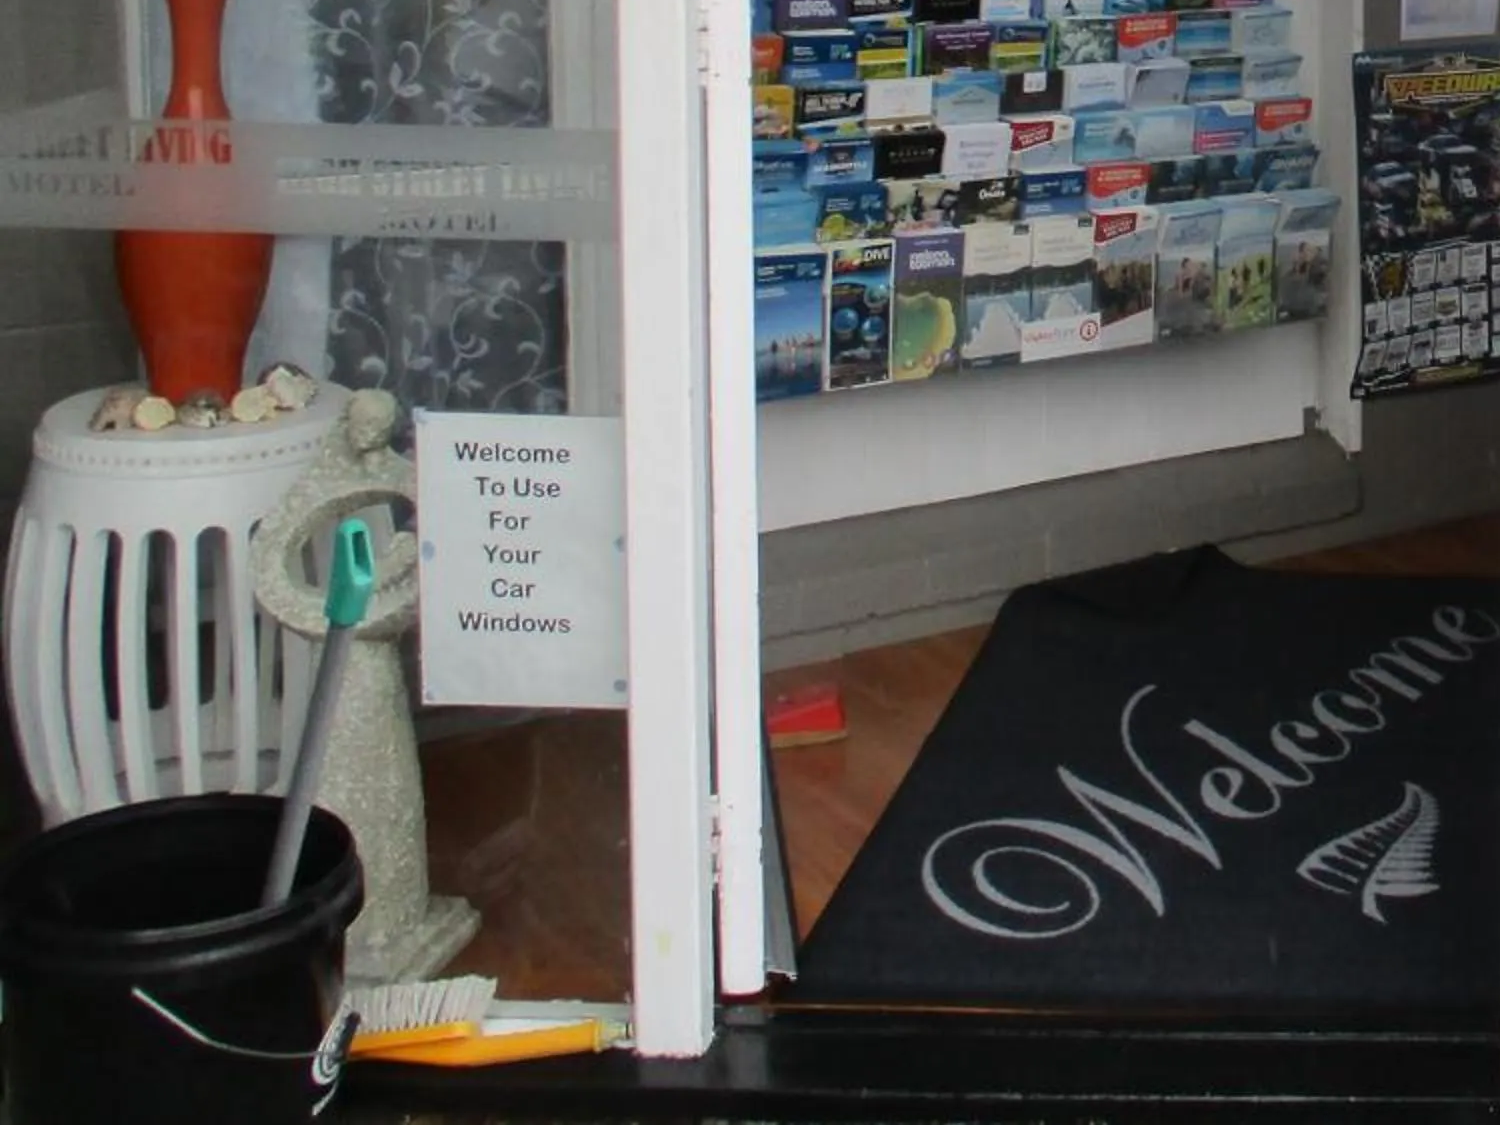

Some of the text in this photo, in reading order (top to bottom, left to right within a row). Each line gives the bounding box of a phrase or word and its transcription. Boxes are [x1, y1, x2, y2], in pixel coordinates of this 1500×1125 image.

[455, 442, 571, 464] Welcome
[474, 476, 561, 498] To Use
[489, 510, 530, 531] For
[483, 544, 541, 565] Your
[491, 578, 535, 599] Car
[458, 611, 572, 633] Windows
